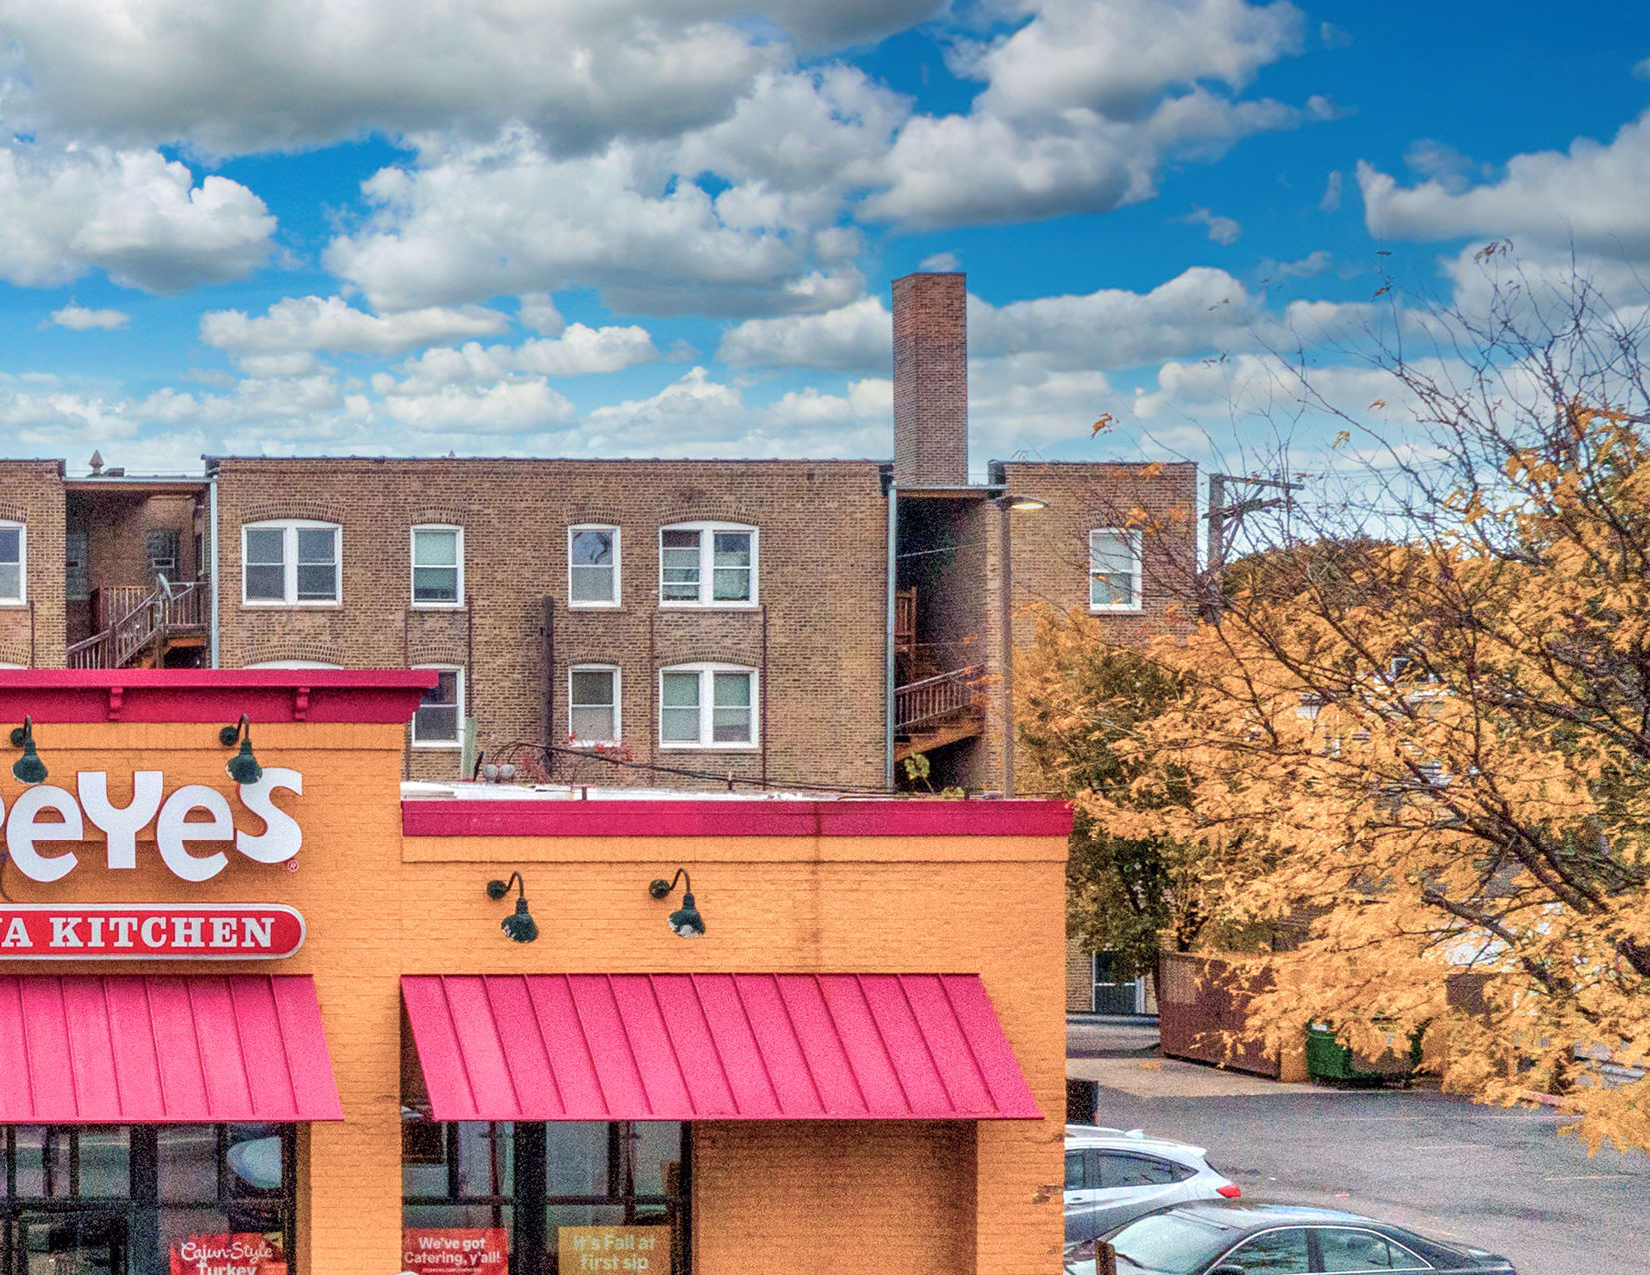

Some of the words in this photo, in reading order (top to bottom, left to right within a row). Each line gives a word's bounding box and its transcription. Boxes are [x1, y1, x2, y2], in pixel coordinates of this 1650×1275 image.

[49, 916, 275, 948] KITCHEN
[418, 1237, 461, 1249] We've
[462, 1237, 486, 1252] got
[604, 1234, 635, 1250] Fall
[638, 1235, 656, 1250] at
[181, 1241, 274, 1264] Cajun-Style
[404, 1251, 468, 1267] Catering,
[623, 1254, 649, 1271] sip
